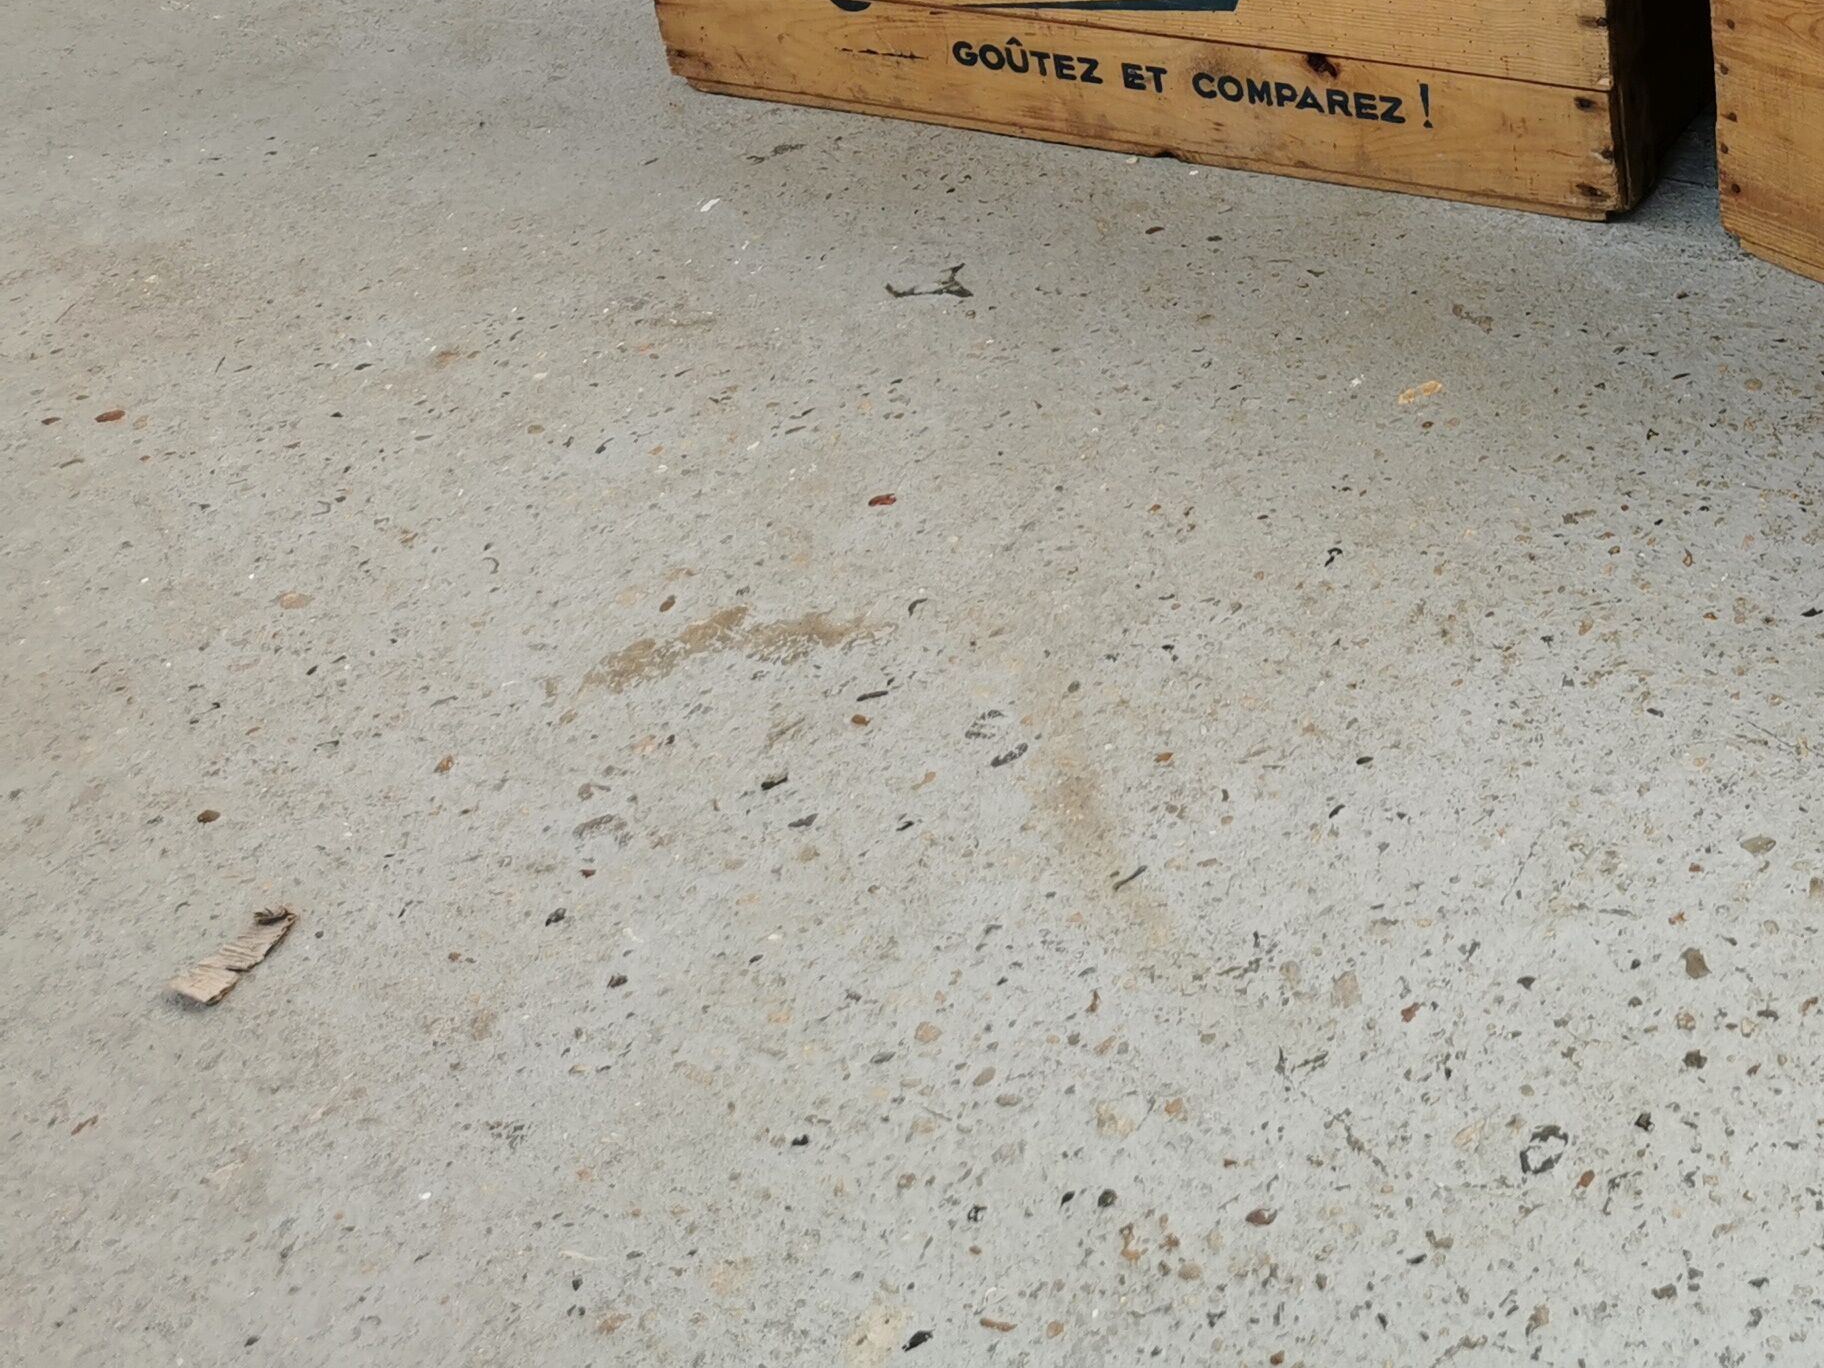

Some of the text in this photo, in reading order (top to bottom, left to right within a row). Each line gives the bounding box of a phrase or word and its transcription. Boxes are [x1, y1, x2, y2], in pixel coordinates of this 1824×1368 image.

[953, 38, 1103, 84] GOÛTEZ
[1123, 63, 1165, 92] ET
[1192, 70, 1404, 125] COMPAREZ
